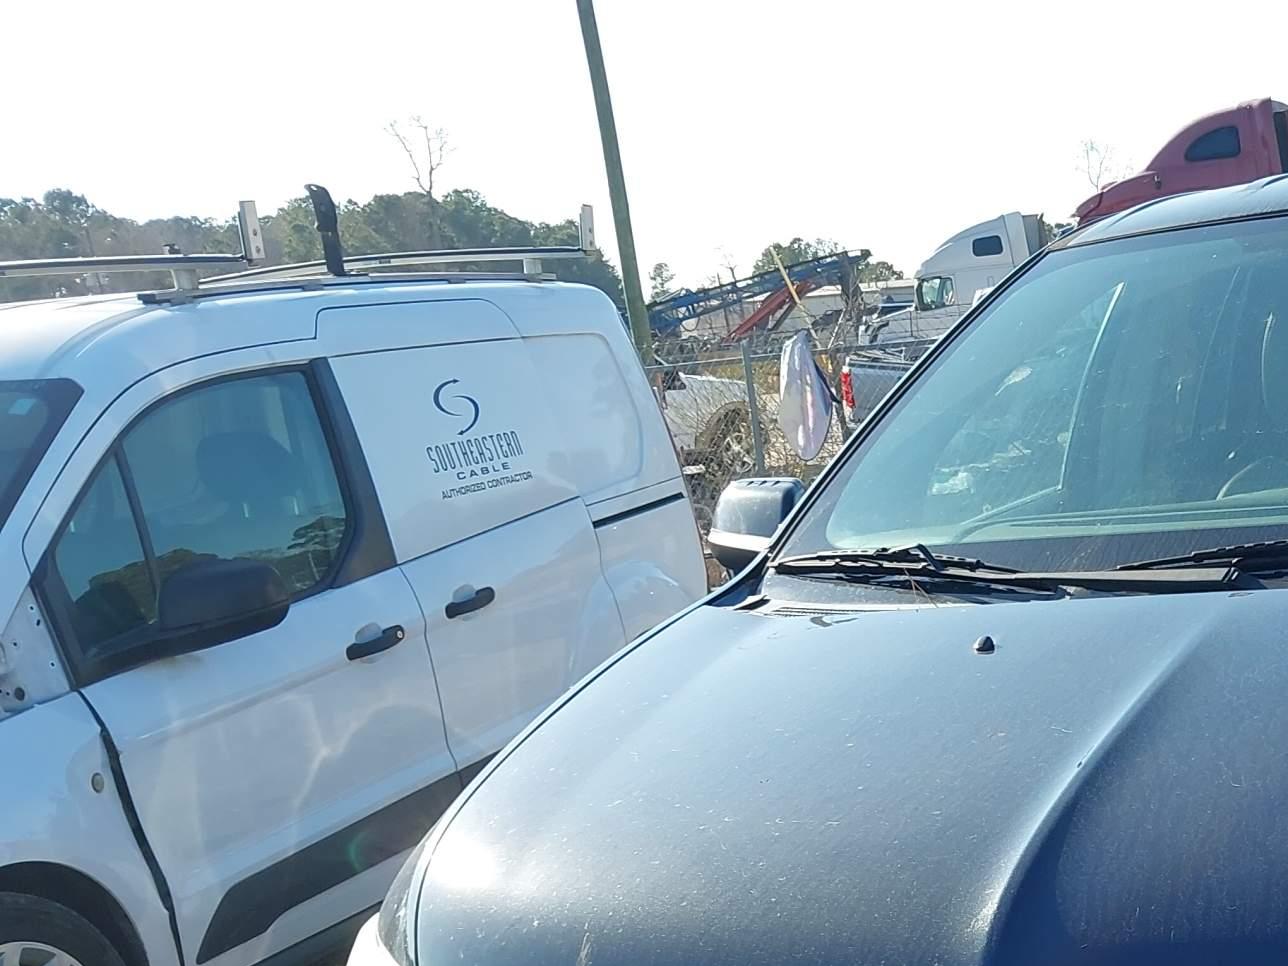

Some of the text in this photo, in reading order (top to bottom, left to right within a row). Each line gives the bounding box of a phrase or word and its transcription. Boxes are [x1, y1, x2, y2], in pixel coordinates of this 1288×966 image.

[426, 430, 524, 473] SOUTHEASTERN
[441, 471, 533, 500] AUTHORIZED CONTRACTOR
[456, 462, 512, 480] CABLE
